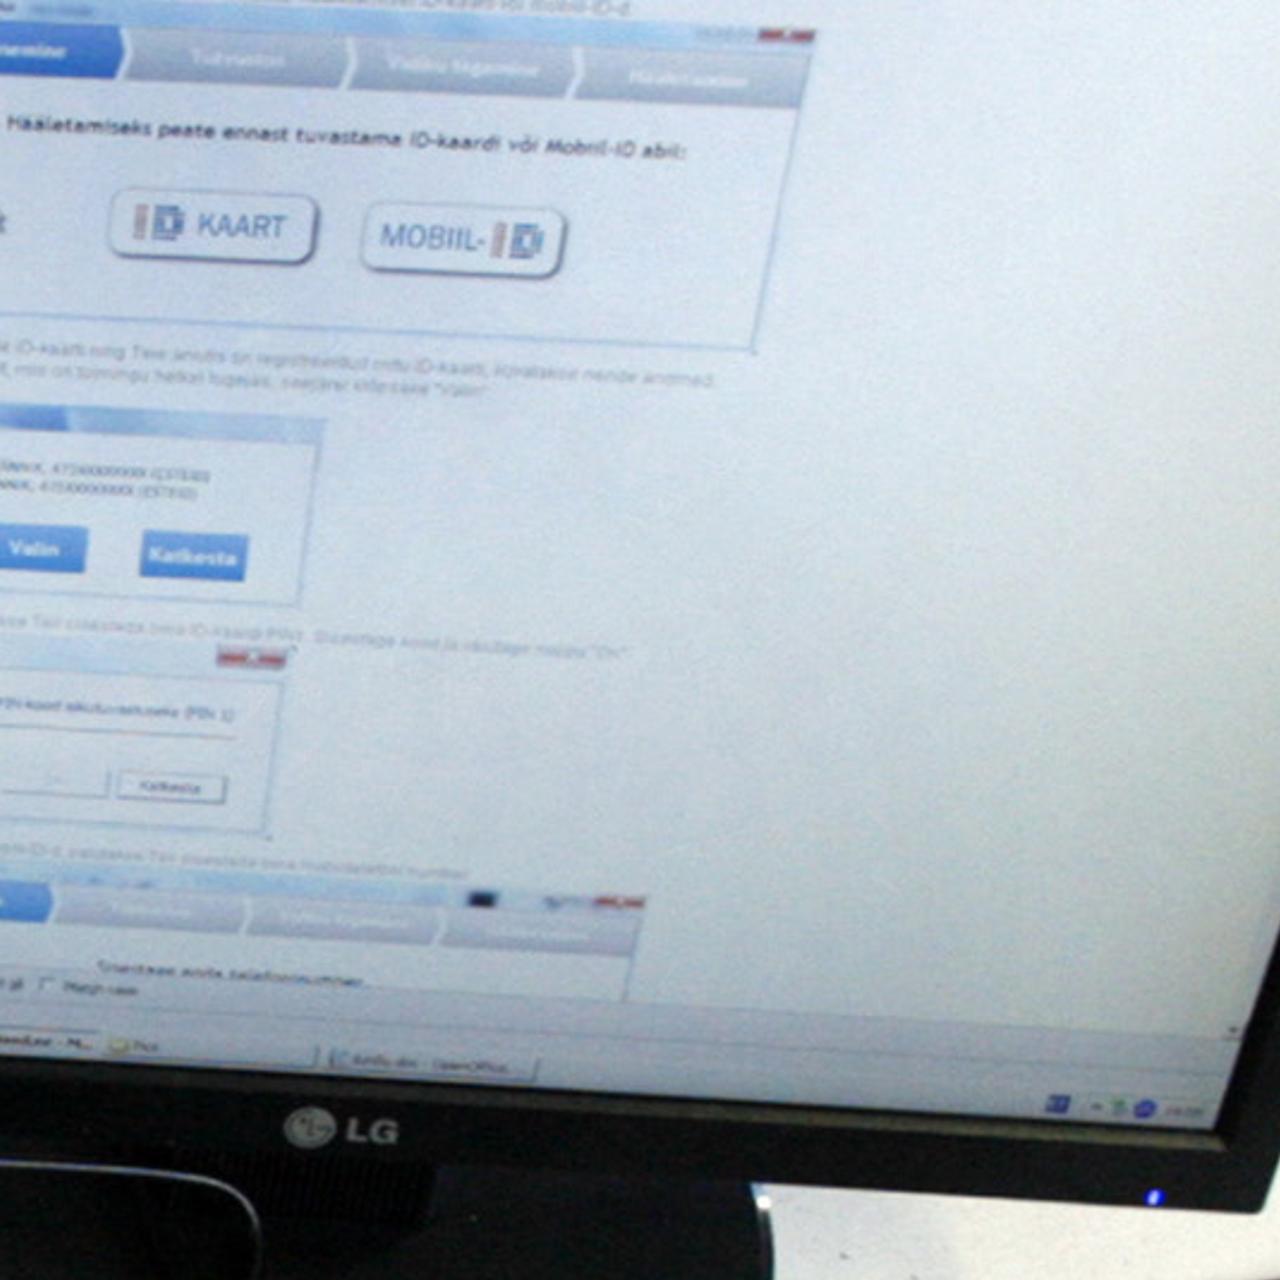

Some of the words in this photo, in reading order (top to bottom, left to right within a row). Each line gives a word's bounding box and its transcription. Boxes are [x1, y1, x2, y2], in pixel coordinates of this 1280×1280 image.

[156, 121, 216, 143] peate
[221, 124, 289, 143] ennast
[294, 128, 402, 148] tuvastama
[409, 130, 501, 153] ID-kaardi
[196, 212, 288, 240] KAART
[346, 1116, 400, 1146] LG
